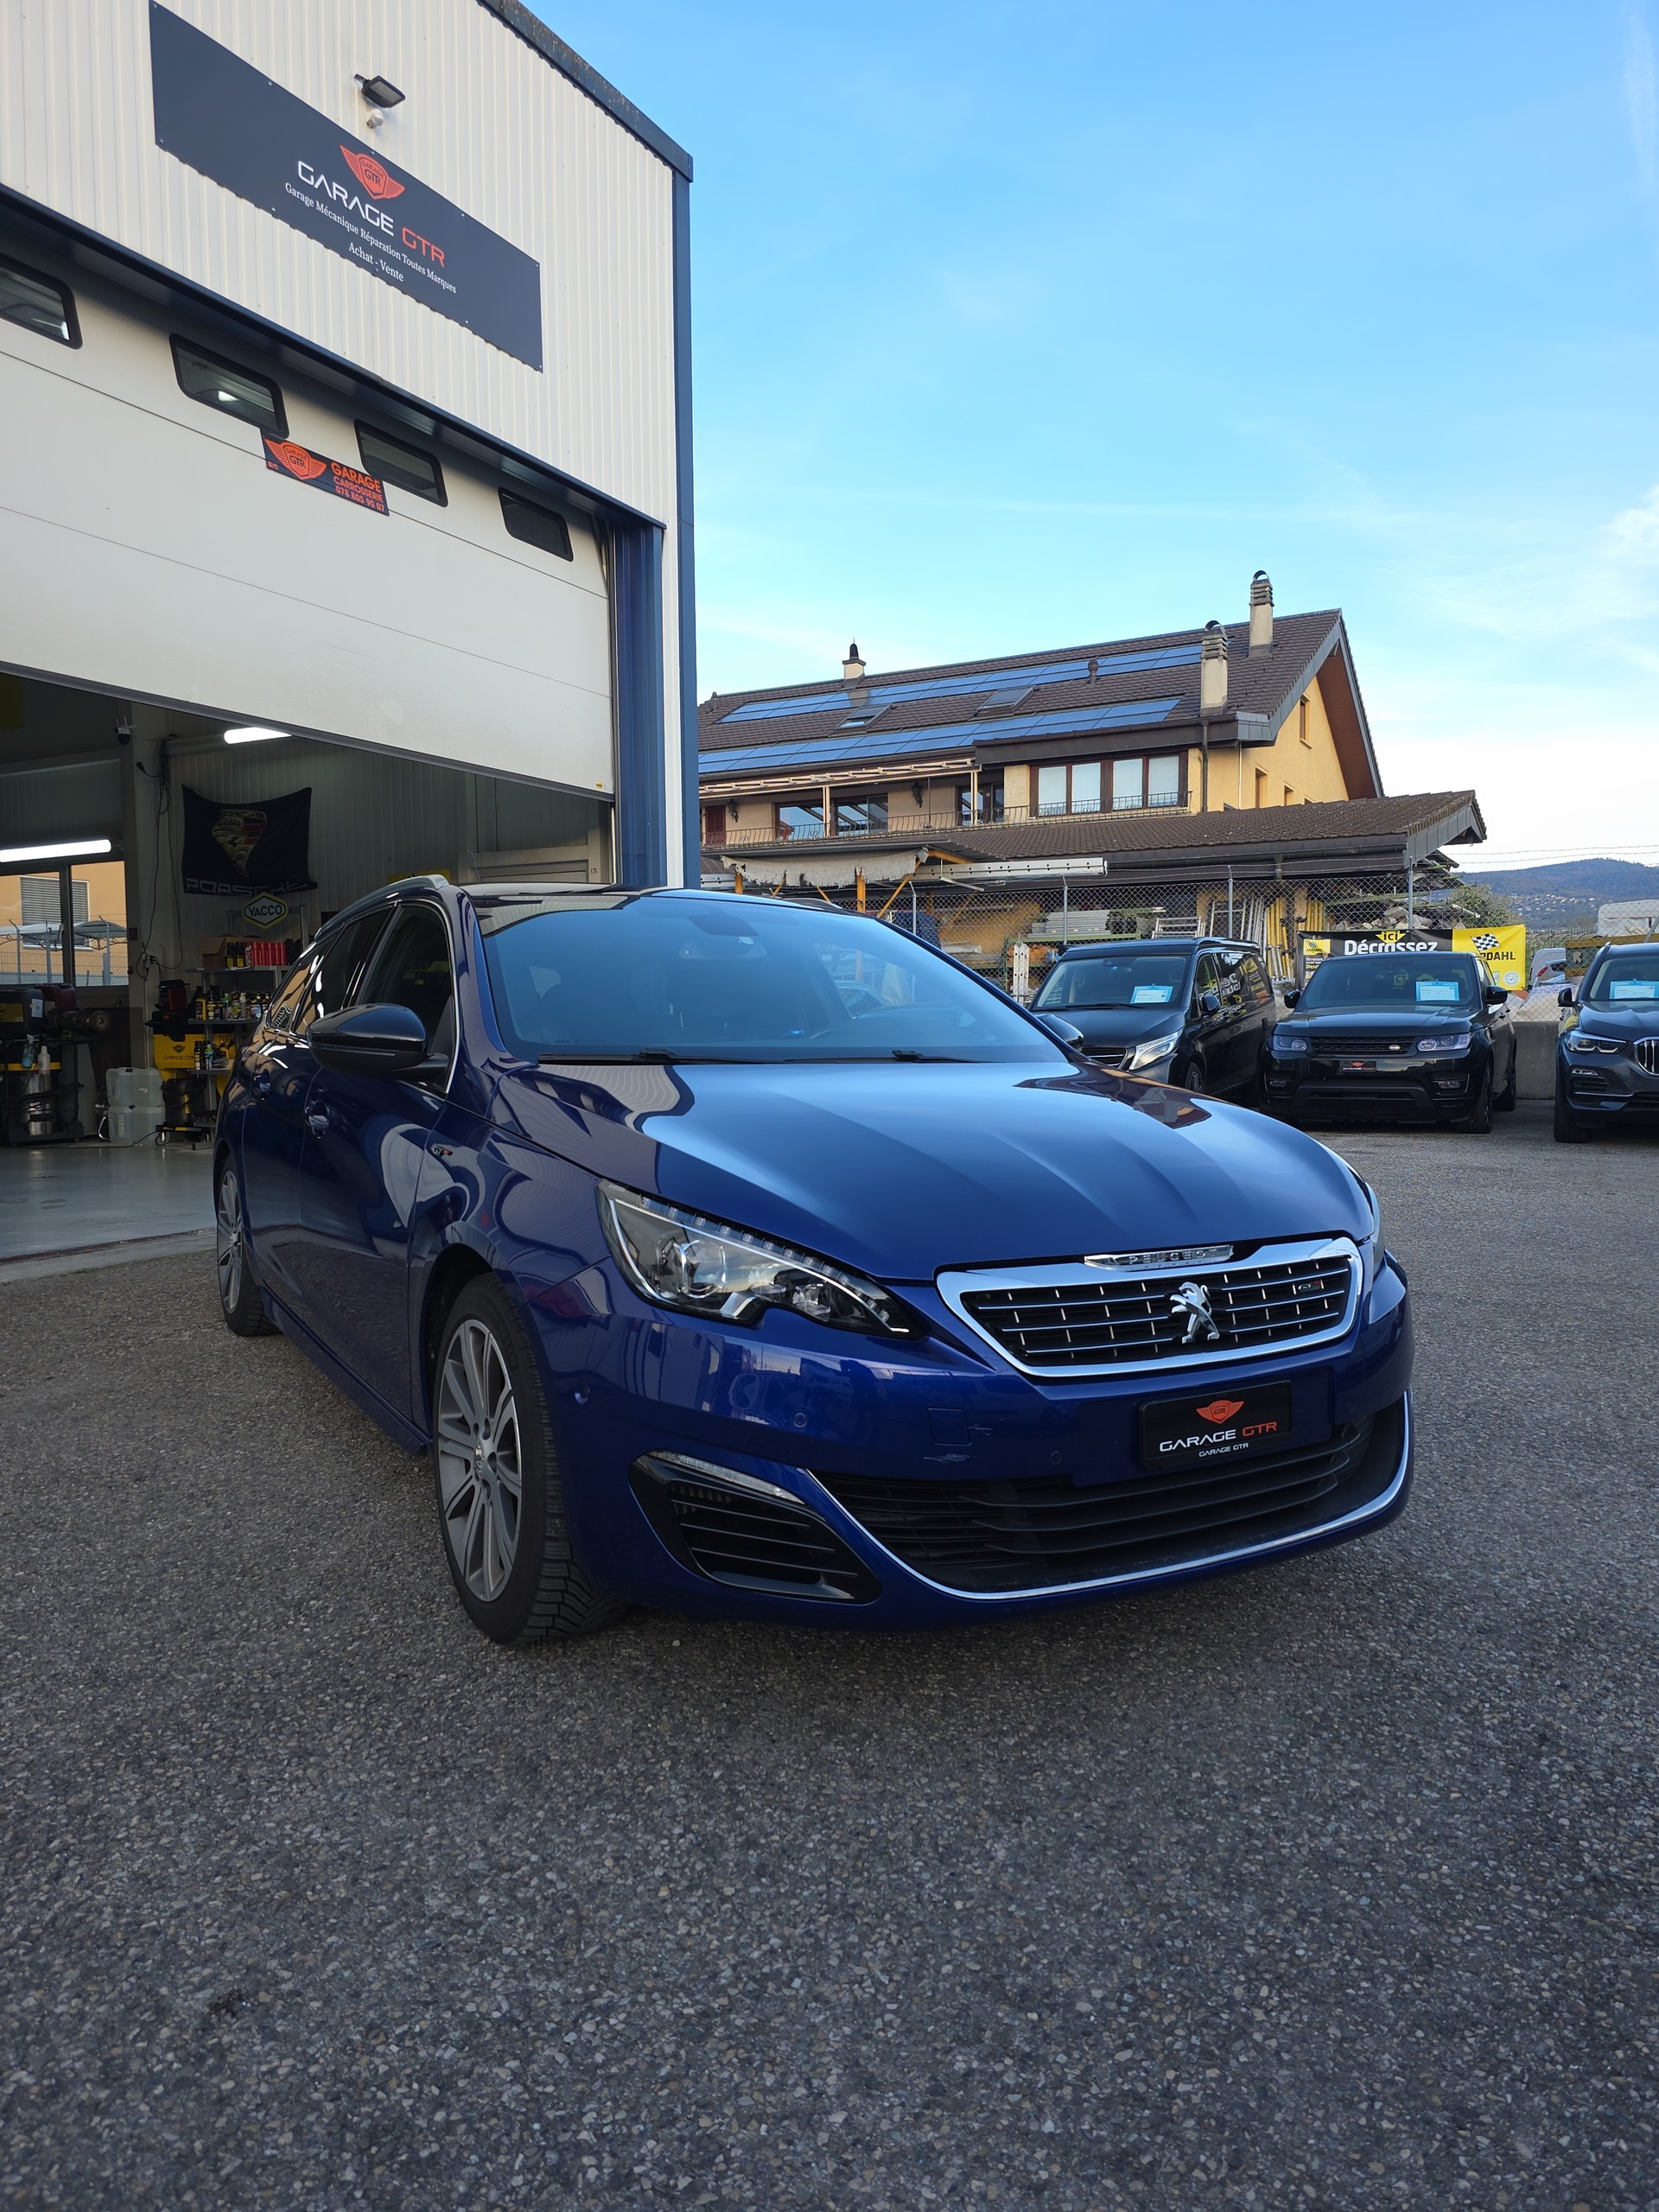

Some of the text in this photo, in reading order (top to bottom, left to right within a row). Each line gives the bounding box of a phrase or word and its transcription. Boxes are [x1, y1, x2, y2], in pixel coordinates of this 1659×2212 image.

[365, 168, 382, 188] GTR
[298, 160, 445, 267] GARAGE GTR
[285, 182, 457, 294] Garage Mécanique Réparation Toutes Marques
[348, 242, 374, 264] Achat
[379, 259, 404, 282] Vente
[289, 455, 307, 469] GTR
[331, 461, 382, 493] GARAGE
[334, 476, 384, 503] CARROSSERIE
[376, 502, 385, 512] 07
[185, 877, 309, 896] PORSCHE
[248, 905, 283, 918] YACCO
[1344, 939, 1438, 956] Décrassez
[1480, 951, 1516, 961] DAHL
[1160, 1421, 1278, 1452] GARAGE GTR
[1198, 1442, 1249, 1458] GARAGE GTR
